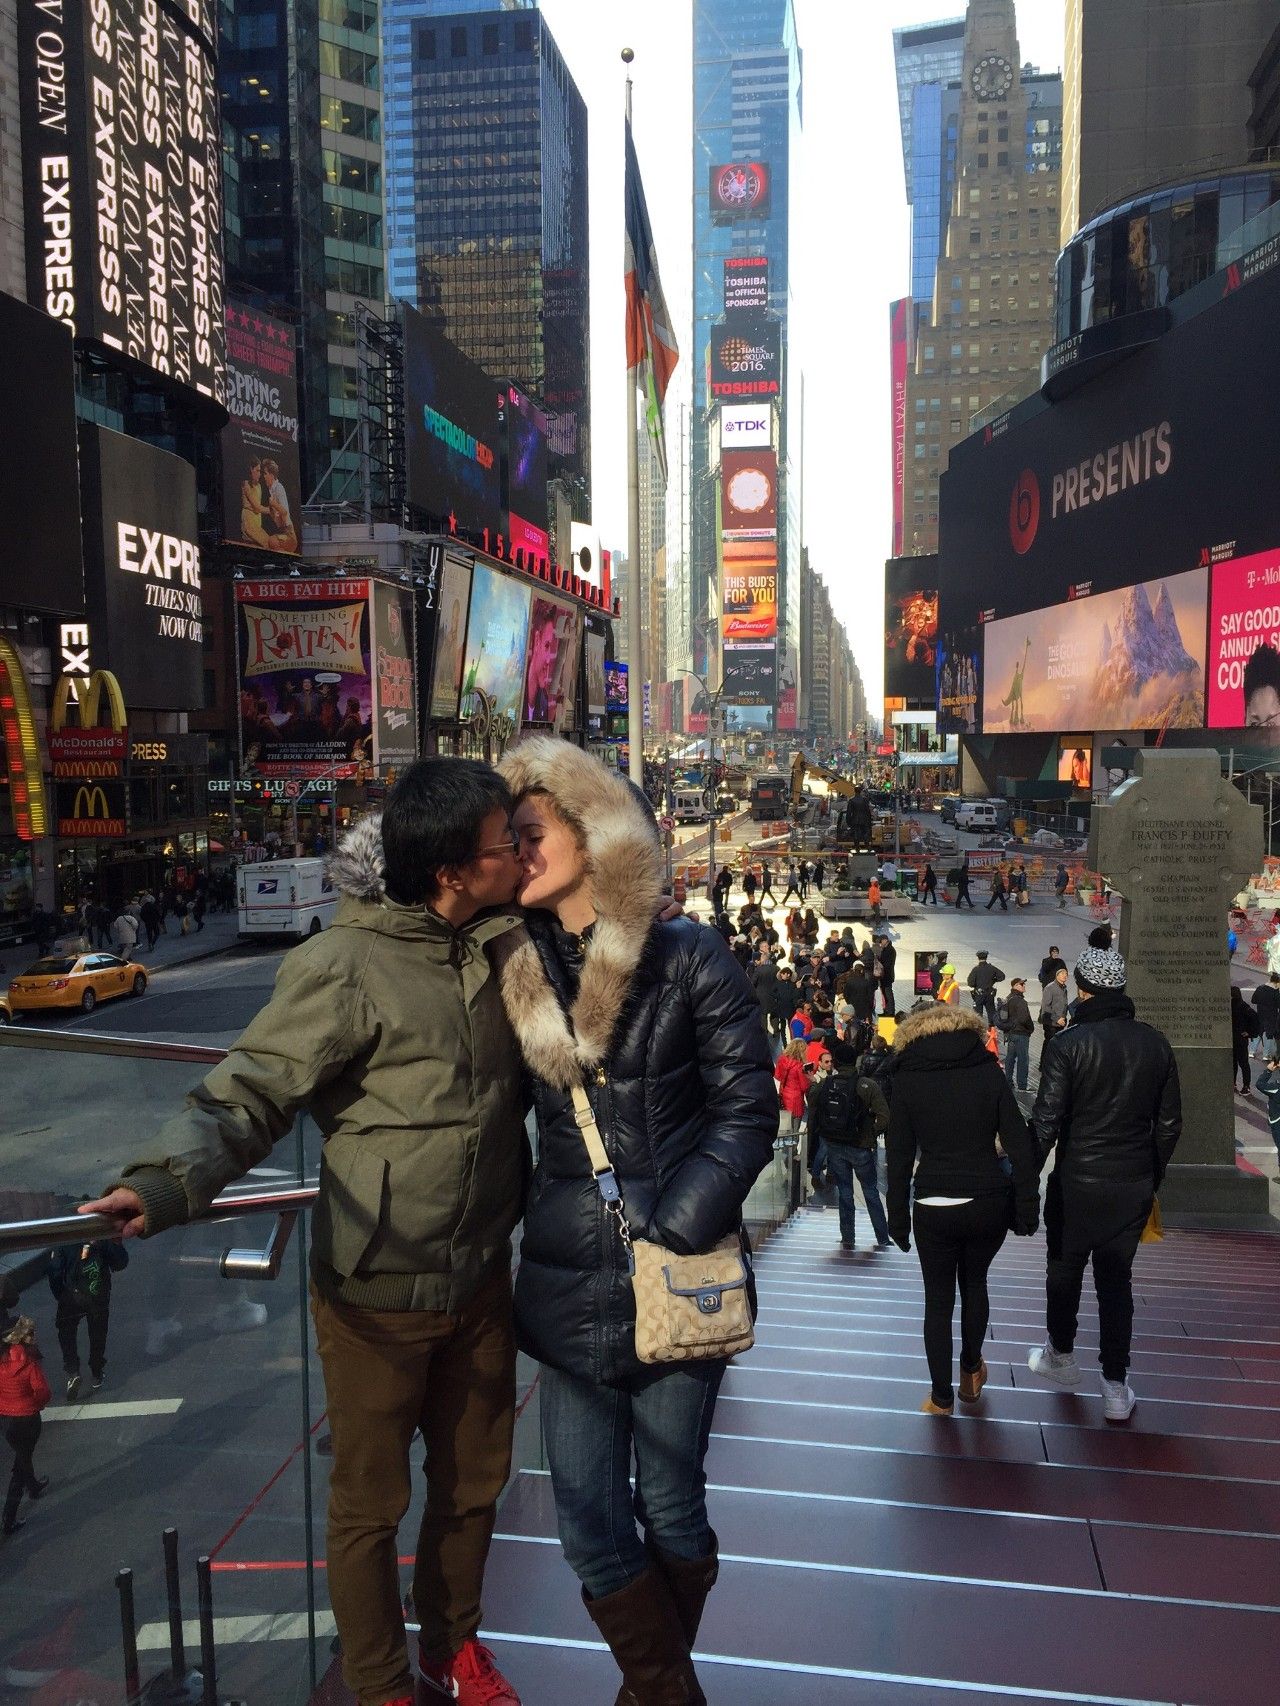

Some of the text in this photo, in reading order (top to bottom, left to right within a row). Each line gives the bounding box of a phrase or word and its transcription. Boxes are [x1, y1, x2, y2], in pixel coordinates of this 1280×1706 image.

[35, 32, 67, 134] OPEN
[117, 7, 138, 146] OPEN
[163, 58, 183, 186] OPEN
[92, 76, 122, 318] EXPRESS
[121, 147, 144, 274] NOW
[168, 187, 189, 306] NOW
[1244, 236, 1280, 267] MARRIOT
[188, 154, 212, 367] EXPRESS
[725, 258, 768, 267] TOSHIBA
[1243, 252, 1278, 280] MARQUIS
[725, 277, 767, 287] TOSHIBA
[735, 288, 766, 296] OFFICIAL
[726, 299, 759, 307] SPONSOR
[744, 353, 775, 361] SQUARE
[227, 364, 281, 410] SPRING
[713, 381, 778, 395] TOSHIBA
[227, 395, 299, 443] wakening
[734, 420, 767, 431] TDK
[1052, 420, 1171, 519] PRESENTS
[1211, 540, 1237, 553] MARRIOTT
[1211, 551, 1233, 562] MARQUIS
[725, 576, 775, 588] THIS BUD'S
[293, 583, 323, 596] FAT
[724, 588, 775, 603] FOR YOU
[145, 584, 185, 612] TIMES
[261, 610, 347, 622] SOMETHING
[159, 614, 187, 640] NOW
[730, 620, 769, 630] Budweiser
[1221, 612, 1244, 636] SAY
[1218, 661, 1246, 691] CO
[52, 736, 124, 748] McDonald's
[64, 748, 112, 756] Restaurant
[264, 780, 337, 792] LUAGE
[1131, 830, 1178, 841] FRANCIS
[1192, 830, 1233, 841] DUFFY
[1143, 855, 1218, 864] CATHOLIC PRIEST
[1160, 875, 1201, 883] CHAPLAIN
[1185, 915, 1218, 923] SERVICE
[1140, 930, 1219, 938] GOD AND COUNTRY
[1204, 959, 1230, 967] GUARD
